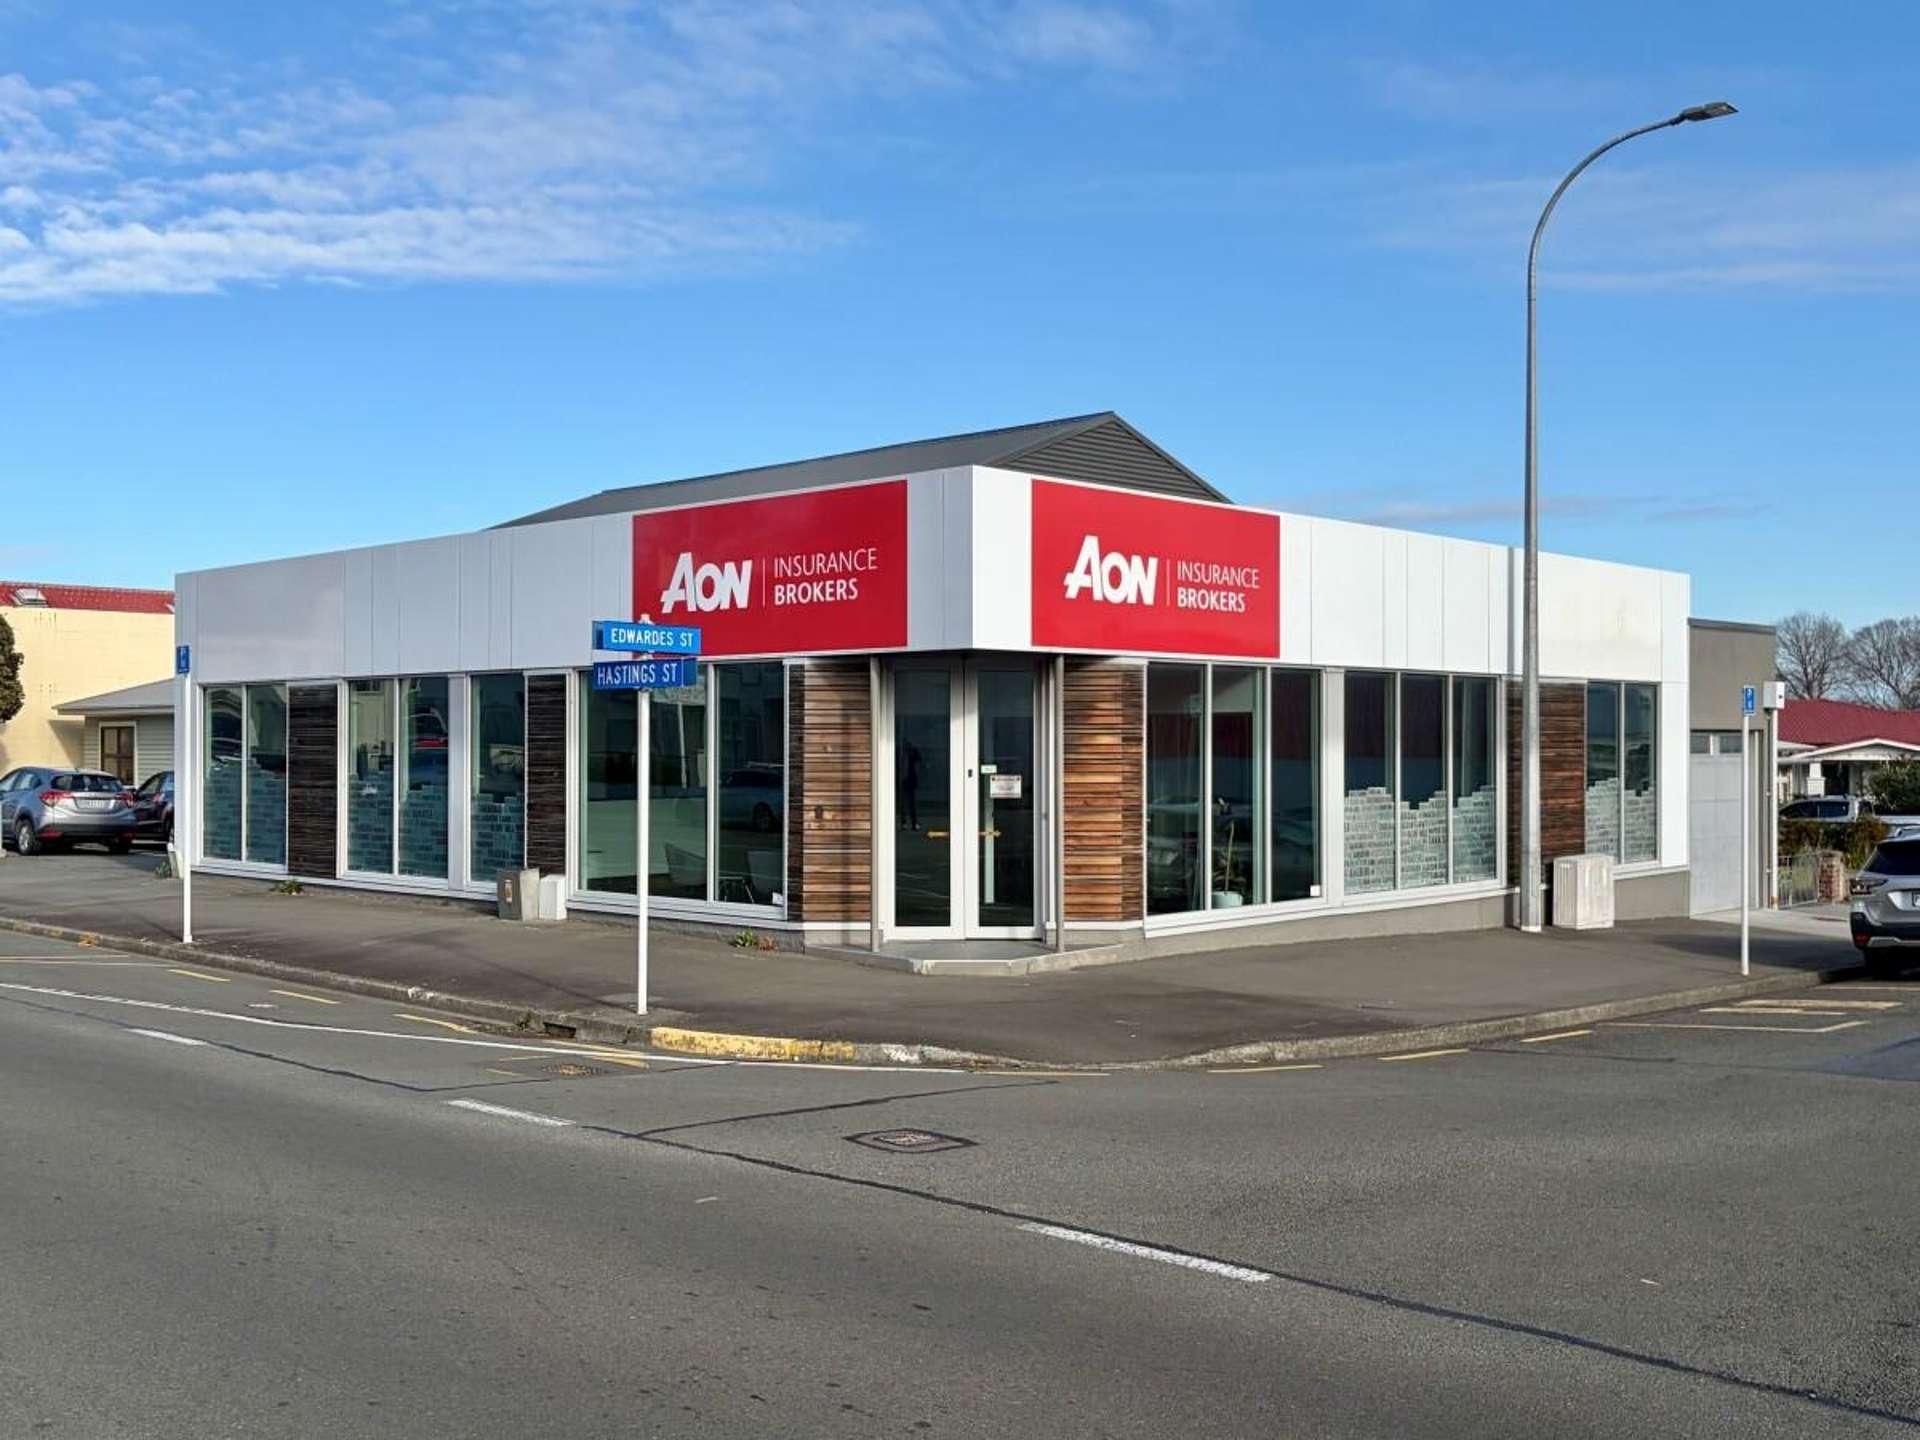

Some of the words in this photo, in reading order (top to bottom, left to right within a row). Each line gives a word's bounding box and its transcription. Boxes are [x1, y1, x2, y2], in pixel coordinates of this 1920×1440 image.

[774, 548, 878, 578] INSURANCE
[1064, 535, 1159, 606] AON
[1177, 562, 1260, 589] INSURANCE
[661, 552, 752, 613] AON
[774, 578, 858, 606] BROKERS
[1177, 587, 1246, 613] BROKERS
[611, 628, 674, 646] EDWARDES
[680, 632, 693, 647] ST
[598, 664, 656, 685] HASTINGS
[663, 663, 677, 682] ST
